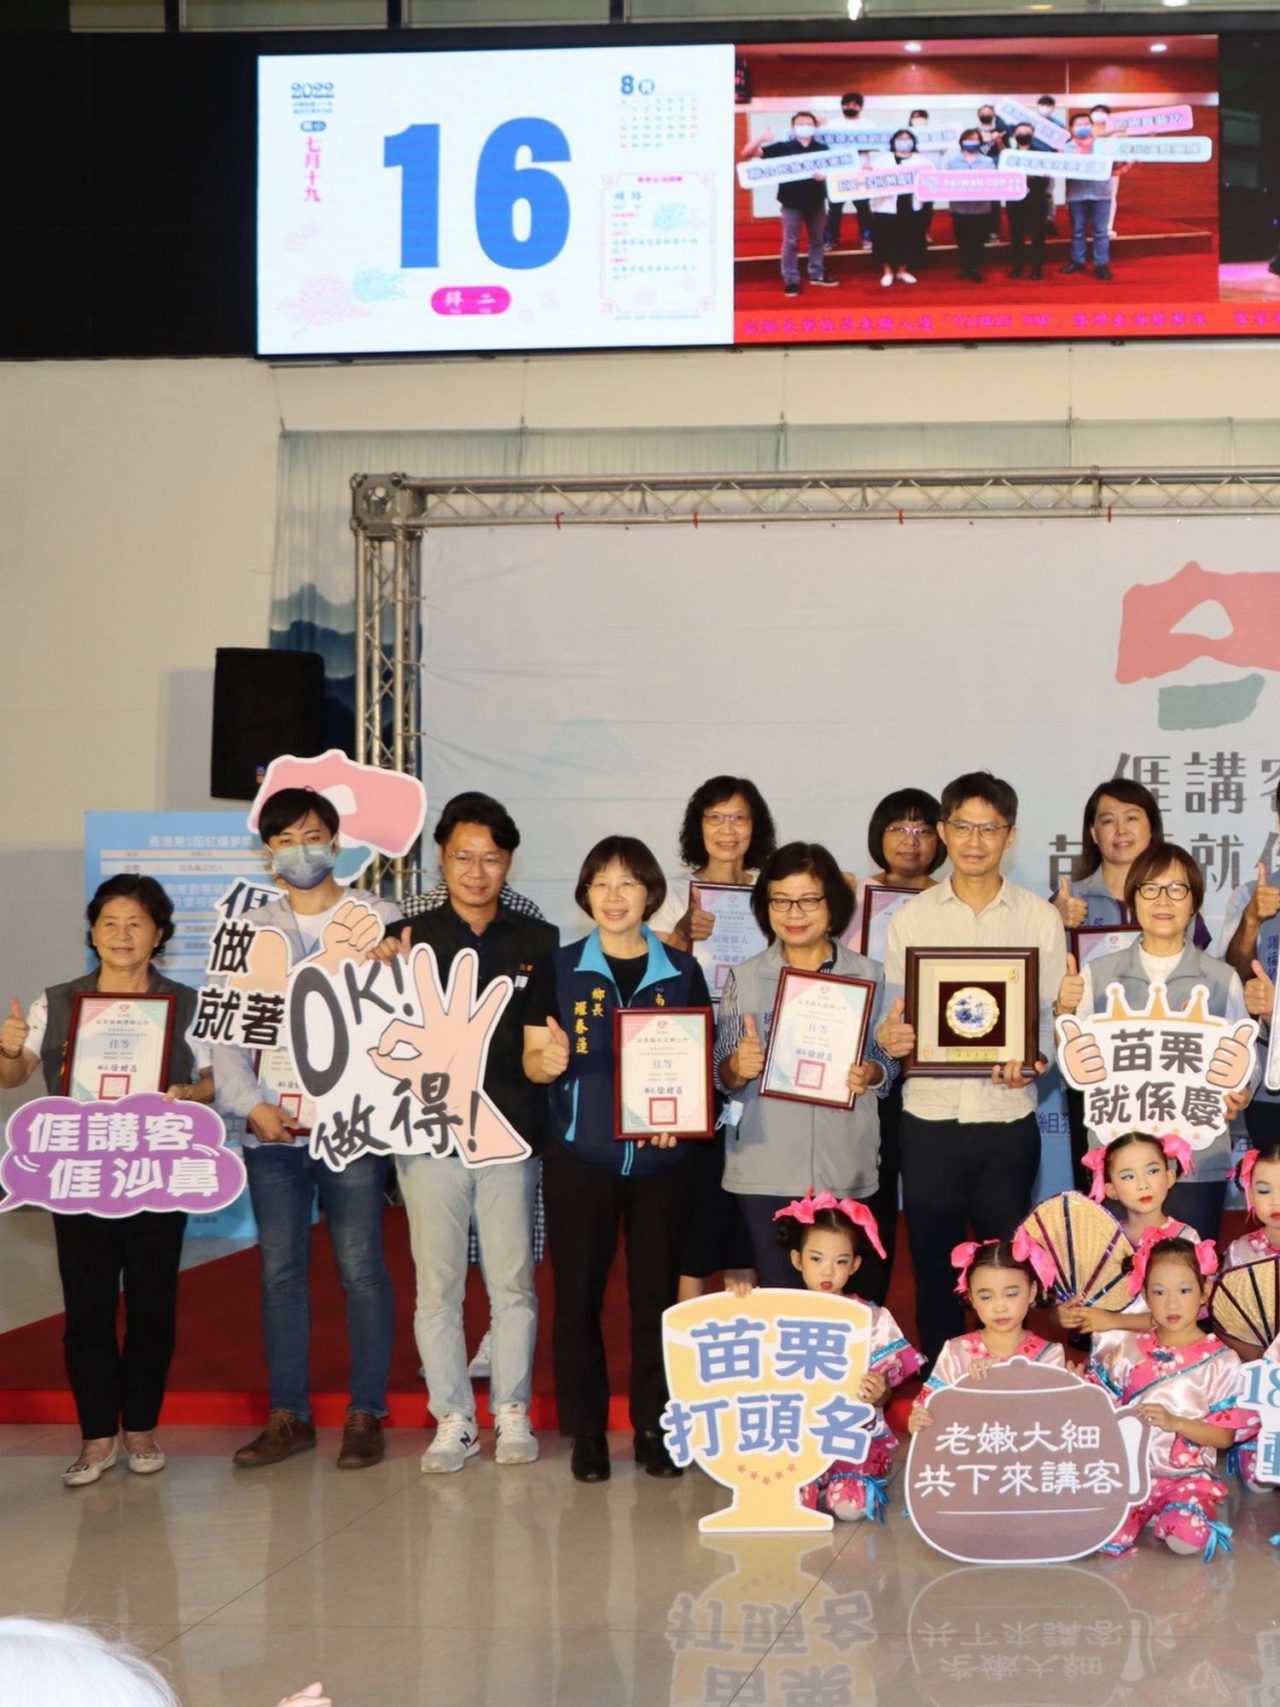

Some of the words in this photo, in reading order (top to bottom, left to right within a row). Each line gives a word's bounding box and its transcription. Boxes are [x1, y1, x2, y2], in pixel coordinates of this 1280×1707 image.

[291, 82, 334, 99] 2022
[621, 75, 634, 95] 8
[305, 136, 321, 203] 七月十九
[383, 116, 571, 270] 16
[192, 988, 286, 1045] 就著
[290, 956, 414, 1098] OK!
[1111, 1029, 1204, 1074] 苗栗
[315, 1072, 479, 1167] 做得!
[1089, 1081, 1223, 1131] 就係慶
[690, 1318, 853, 1384] 苗栗
[664, 1393, 875, 1464] 打頭名
[935, 1419, 1102, 1457] 老嫩大細
[914, 1460, 1124, 1498] 共下來講客
